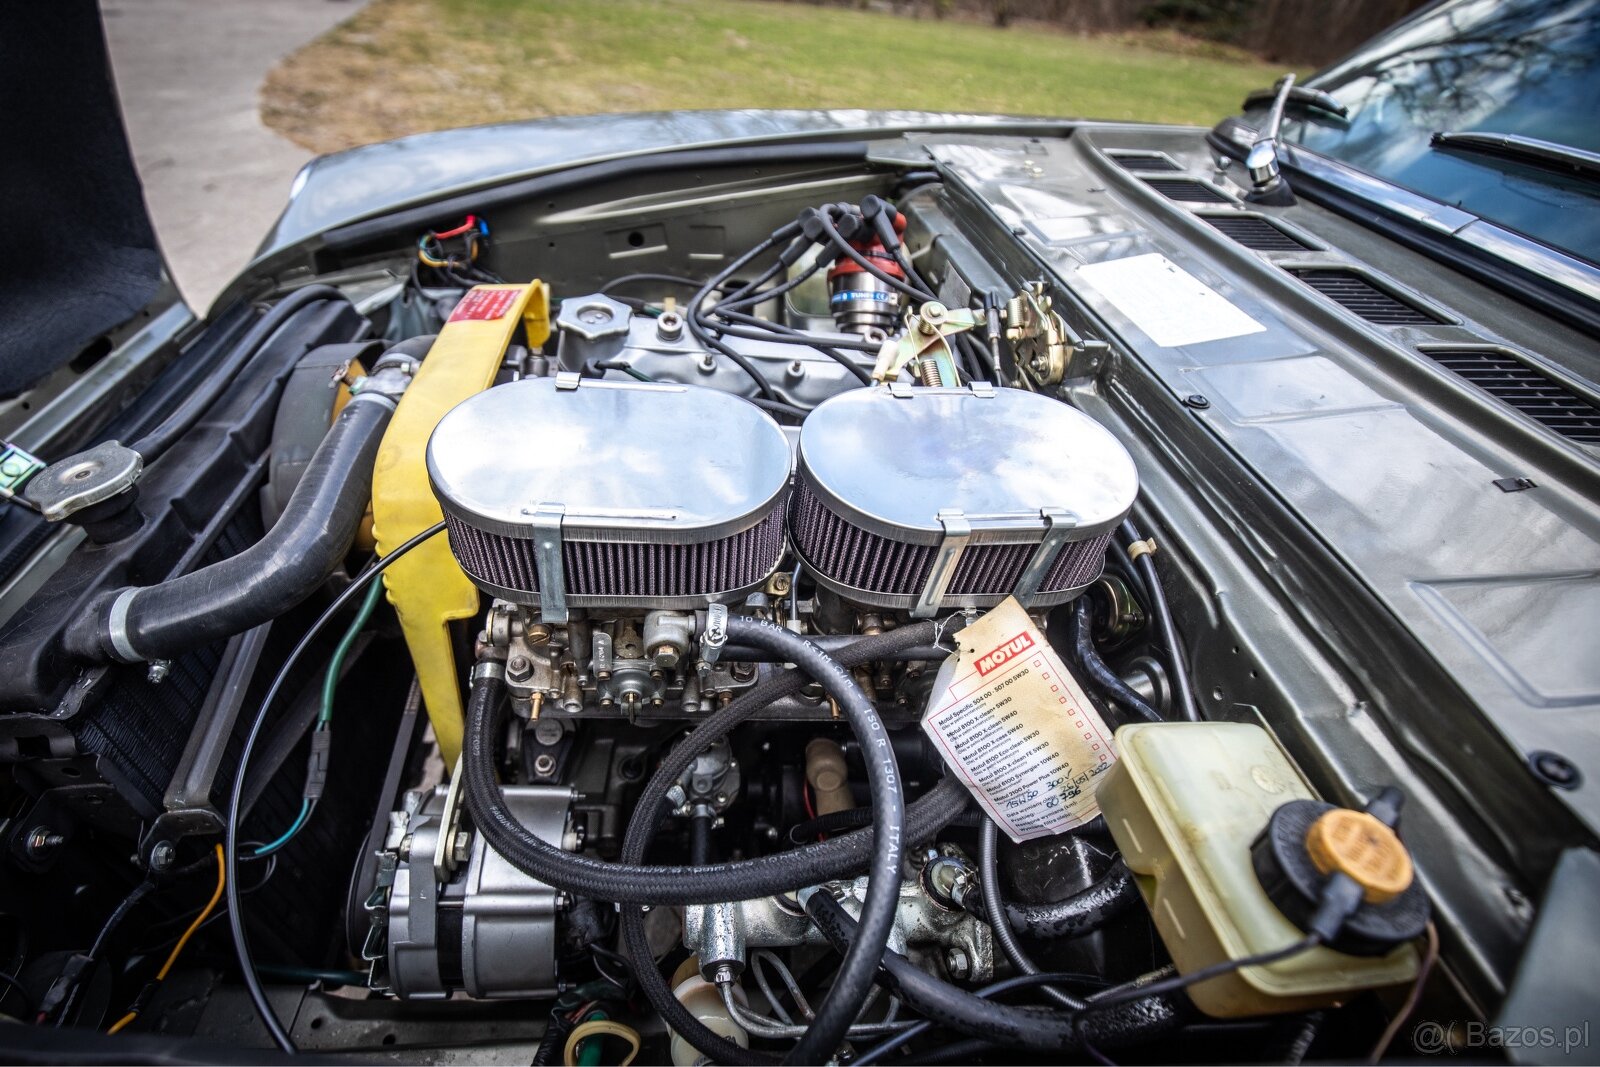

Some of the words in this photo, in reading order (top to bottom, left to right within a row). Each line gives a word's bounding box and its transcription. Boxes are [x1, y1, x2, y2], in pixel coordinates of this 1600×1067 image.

[738, 614, 754, 624] 10
[760, 618, 784, 634] BAR
[978, 633, 1031, 672] MOTUL
[937, 714, 953, 726] Motul
[951, 702, 974, 718] Specific
[971, 695, 984, 705] 504
[982, 690, 992, 699] 00
[993, 682, 1005, 692] 507
[1003, 677, 1014, 686] 00
[1011, 667, 1029, 681] 5W30
[946, 726, 962, 738] Motul
[960, 718, 975, 730] 8100
[973, 705, 996, 722] X-clean+
[995, 695, 1012, 709] 5W30
[863, 708, 880, 732] ISO
[953, 738, 970, 750] Motul
[968, 730, 983, 742] 8100
[981, 718, 1002, 734] X-clean
[1000, 709, 1018, 723] 5W40
[874, 737, 886, 748] R
[962, 749, 978, 762] Motul
[976, 742, 991, 753] 8100
[989, 731, 1008, 745] X-cess
[1006, 722, 1024, 735] 5W40
[970, 760, 986, 773] Motul
[984, 753, 999, 765] 8100
[998, 738, 1024, 757] Eco-clean
[1022, 729, 1040, 743] 5W30
[978, 771, 994, 784] Motul
[992, 764, 1007, 776] 8100
[1006, 753, 1026, 768] X-clean
[1032, 740, 1050, 754] 5W30
[883, 757, 897, 795] 1307
[985, 781, 1002, 795] Motul
[1000, 774, 1015, 787] 6100
[1013, 760, 1041, 780] Synergie+
[1039, 750, 1060, 766] 10W40
[993, 790, 1010, 804] Motul
[1007, 784, 1023, 797] 2100
[1021, 776, 1039, 790] Power
[1037, 771, 1050, 782] Plus
[1049, 760, 1070, 776] 10W40
[1006, 809, 1019, 818] Data
[1018, 800, 1043, 814] wymiany
[886, 824, 901, 874] ITALY
